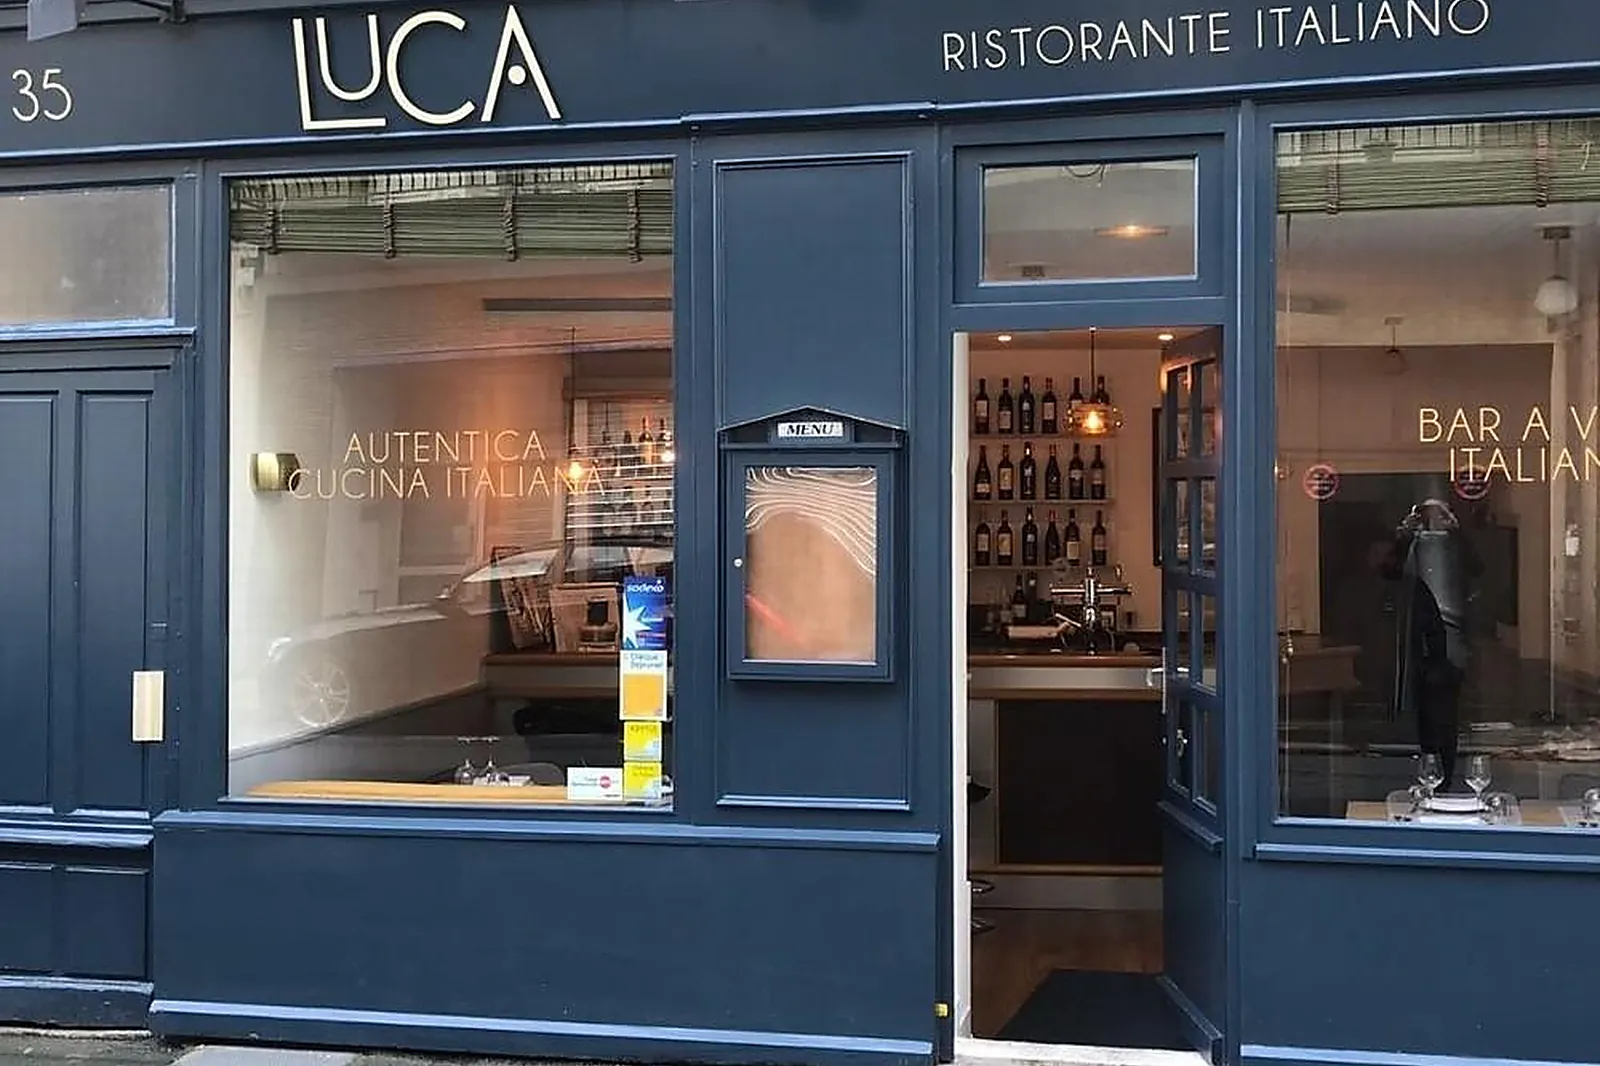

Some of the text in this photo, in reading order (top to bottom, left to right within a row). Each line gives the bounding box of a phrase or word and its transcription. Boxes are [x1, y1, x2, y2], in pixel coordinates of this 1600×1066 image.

[943, 0, 1490, 71] RISTORANTE ITALIANO
[292, 5, 562, 131] LUCA
[11, 68, 74, 122] 35
[786, 424, 835, 436] MENU
[1419, 408, 1500, 442] BAR
[1522, 406, 1550, 442] A
[344, 430, 546, 464] AUTENTICA
[288, 463, 606, 500] CUCINA ITALIANA
